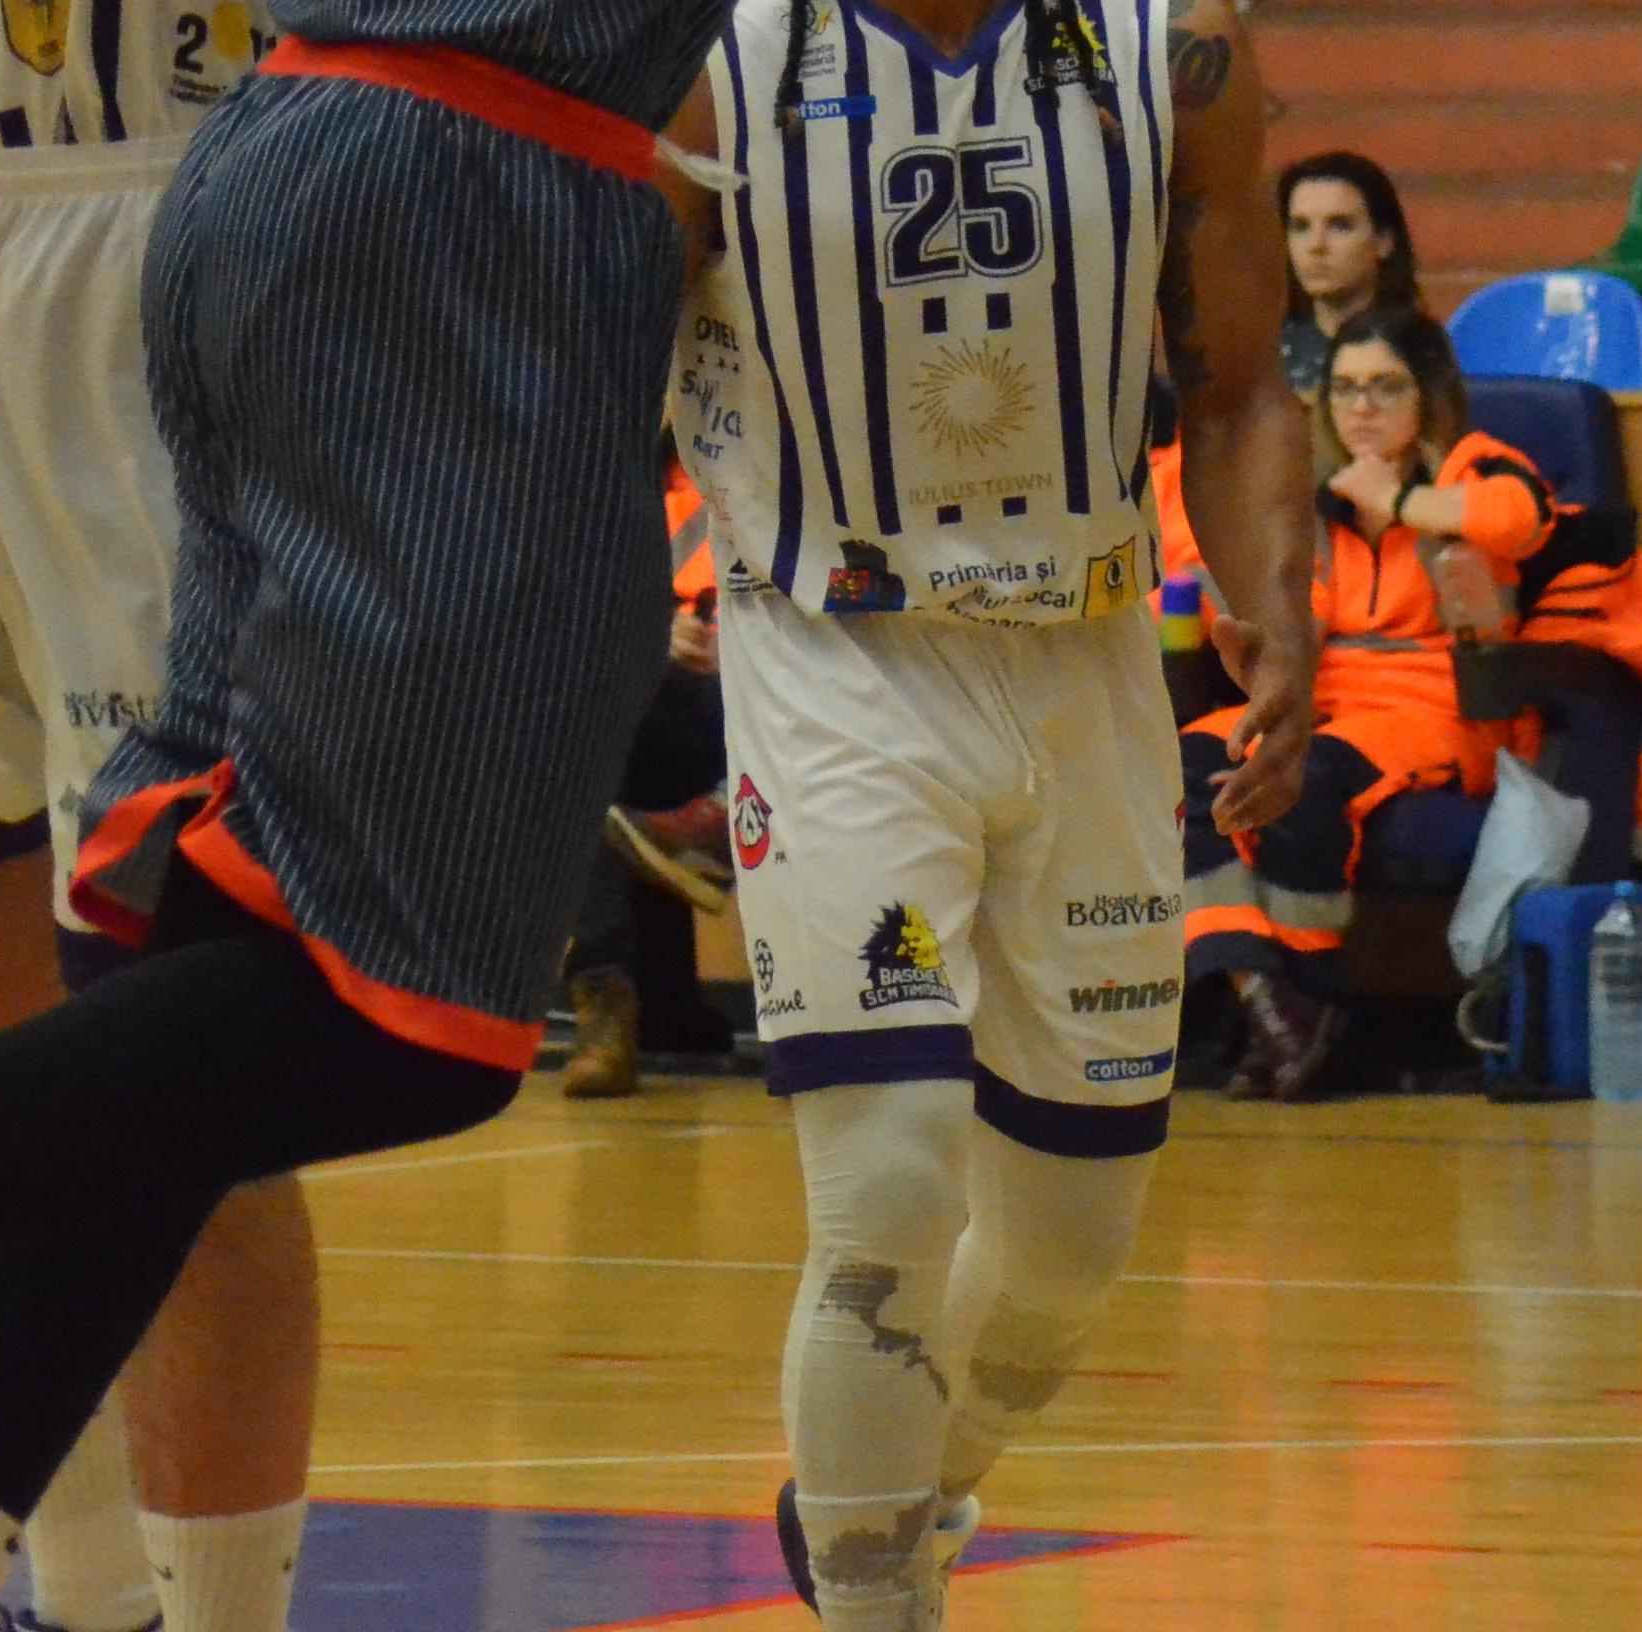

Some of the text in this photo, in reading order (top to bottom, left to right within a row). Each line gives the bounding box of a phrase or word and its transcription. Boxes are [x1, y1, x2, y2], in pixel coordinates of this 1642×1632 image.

[881, 135, 1044, 288] 25
[1066, 894, 1182, 928] Boavista
[1069, 977, 1180, 1014] winne
[1087, 1058, 1155, 1080] cotton
